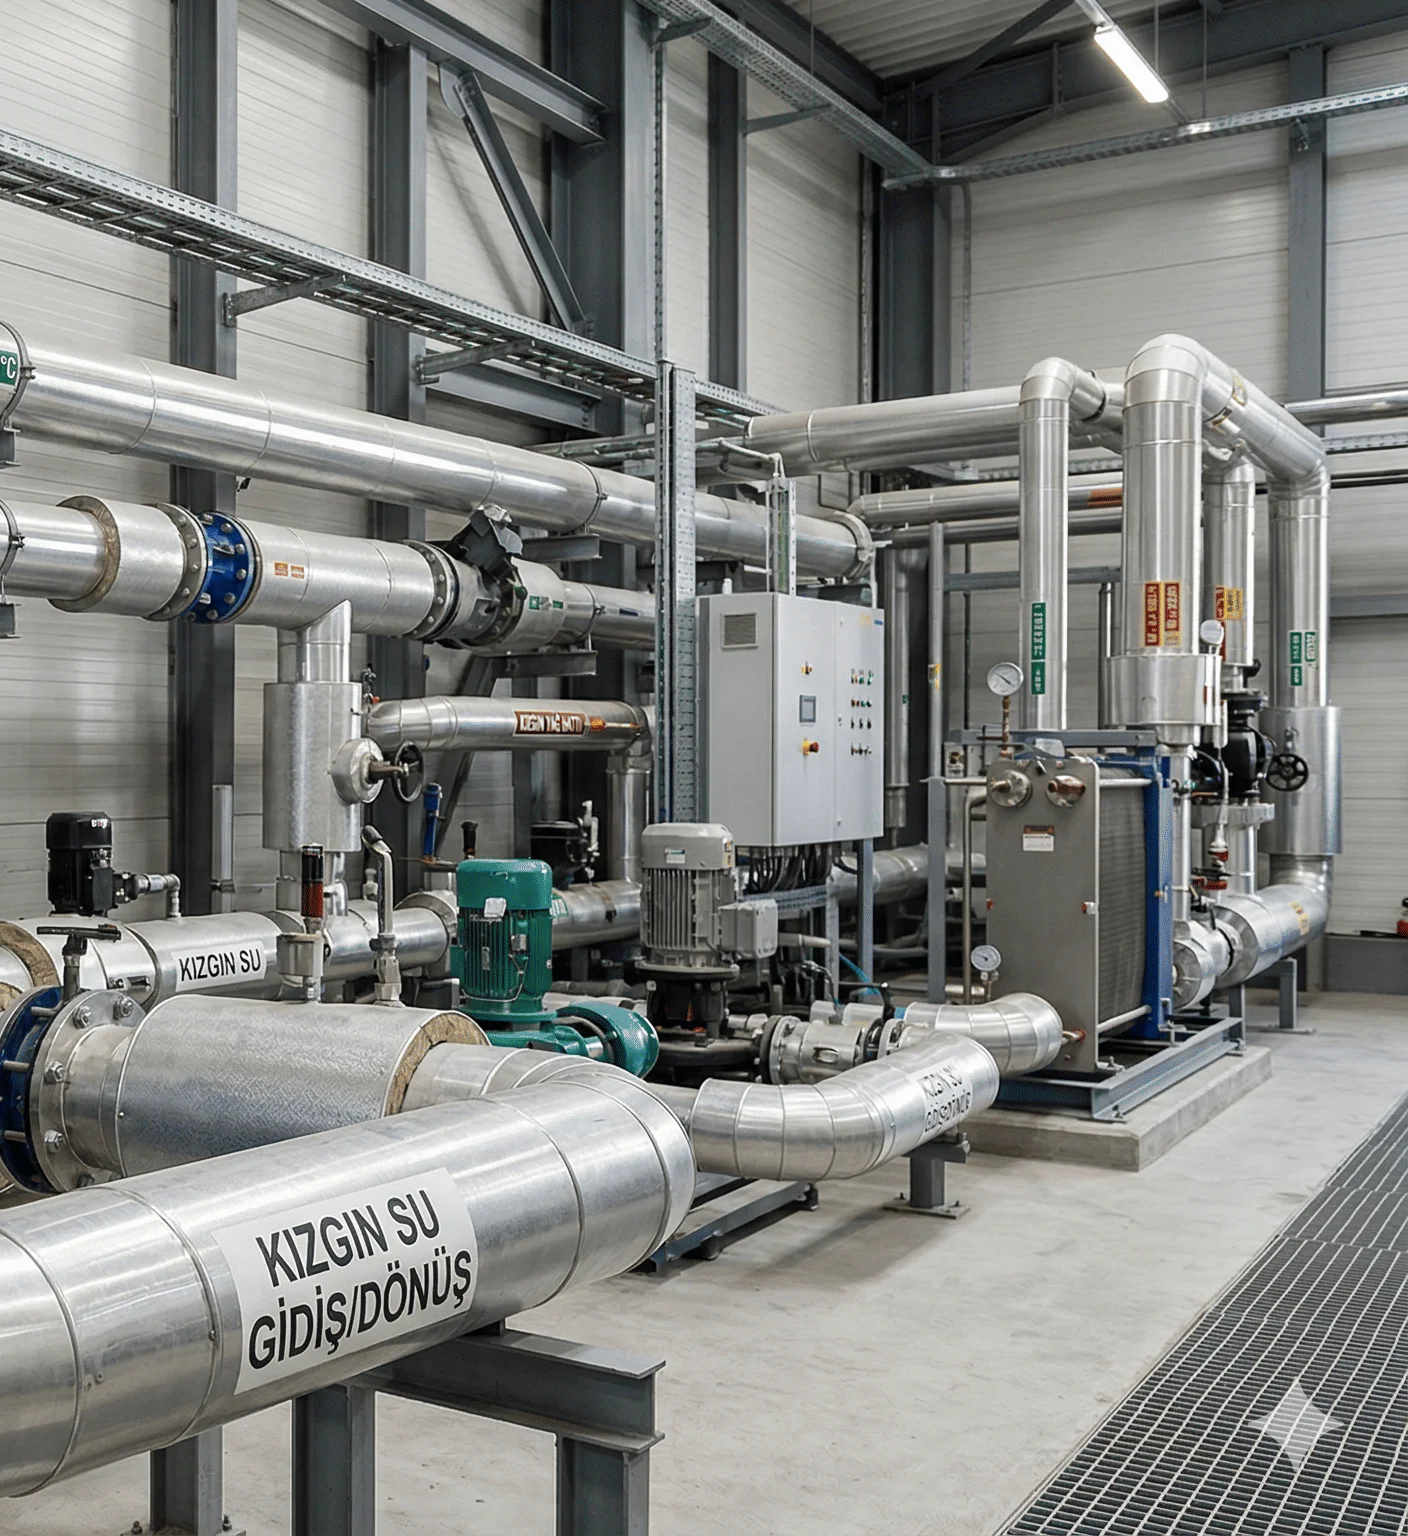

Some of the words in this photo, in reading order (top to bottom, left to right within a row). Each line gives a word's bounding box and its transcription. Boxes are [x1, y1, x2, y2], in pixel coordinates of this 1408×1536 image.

[178, 951, 236, 982] KIZGIN
[239, 948, 261, 973] SU
[255, 1204, 389, 1288] KIZGIN
[387, 1189, 440, 1246] SU
[248, 1245, 472, 1370] GİDİŞ/DÖNÜŞ
